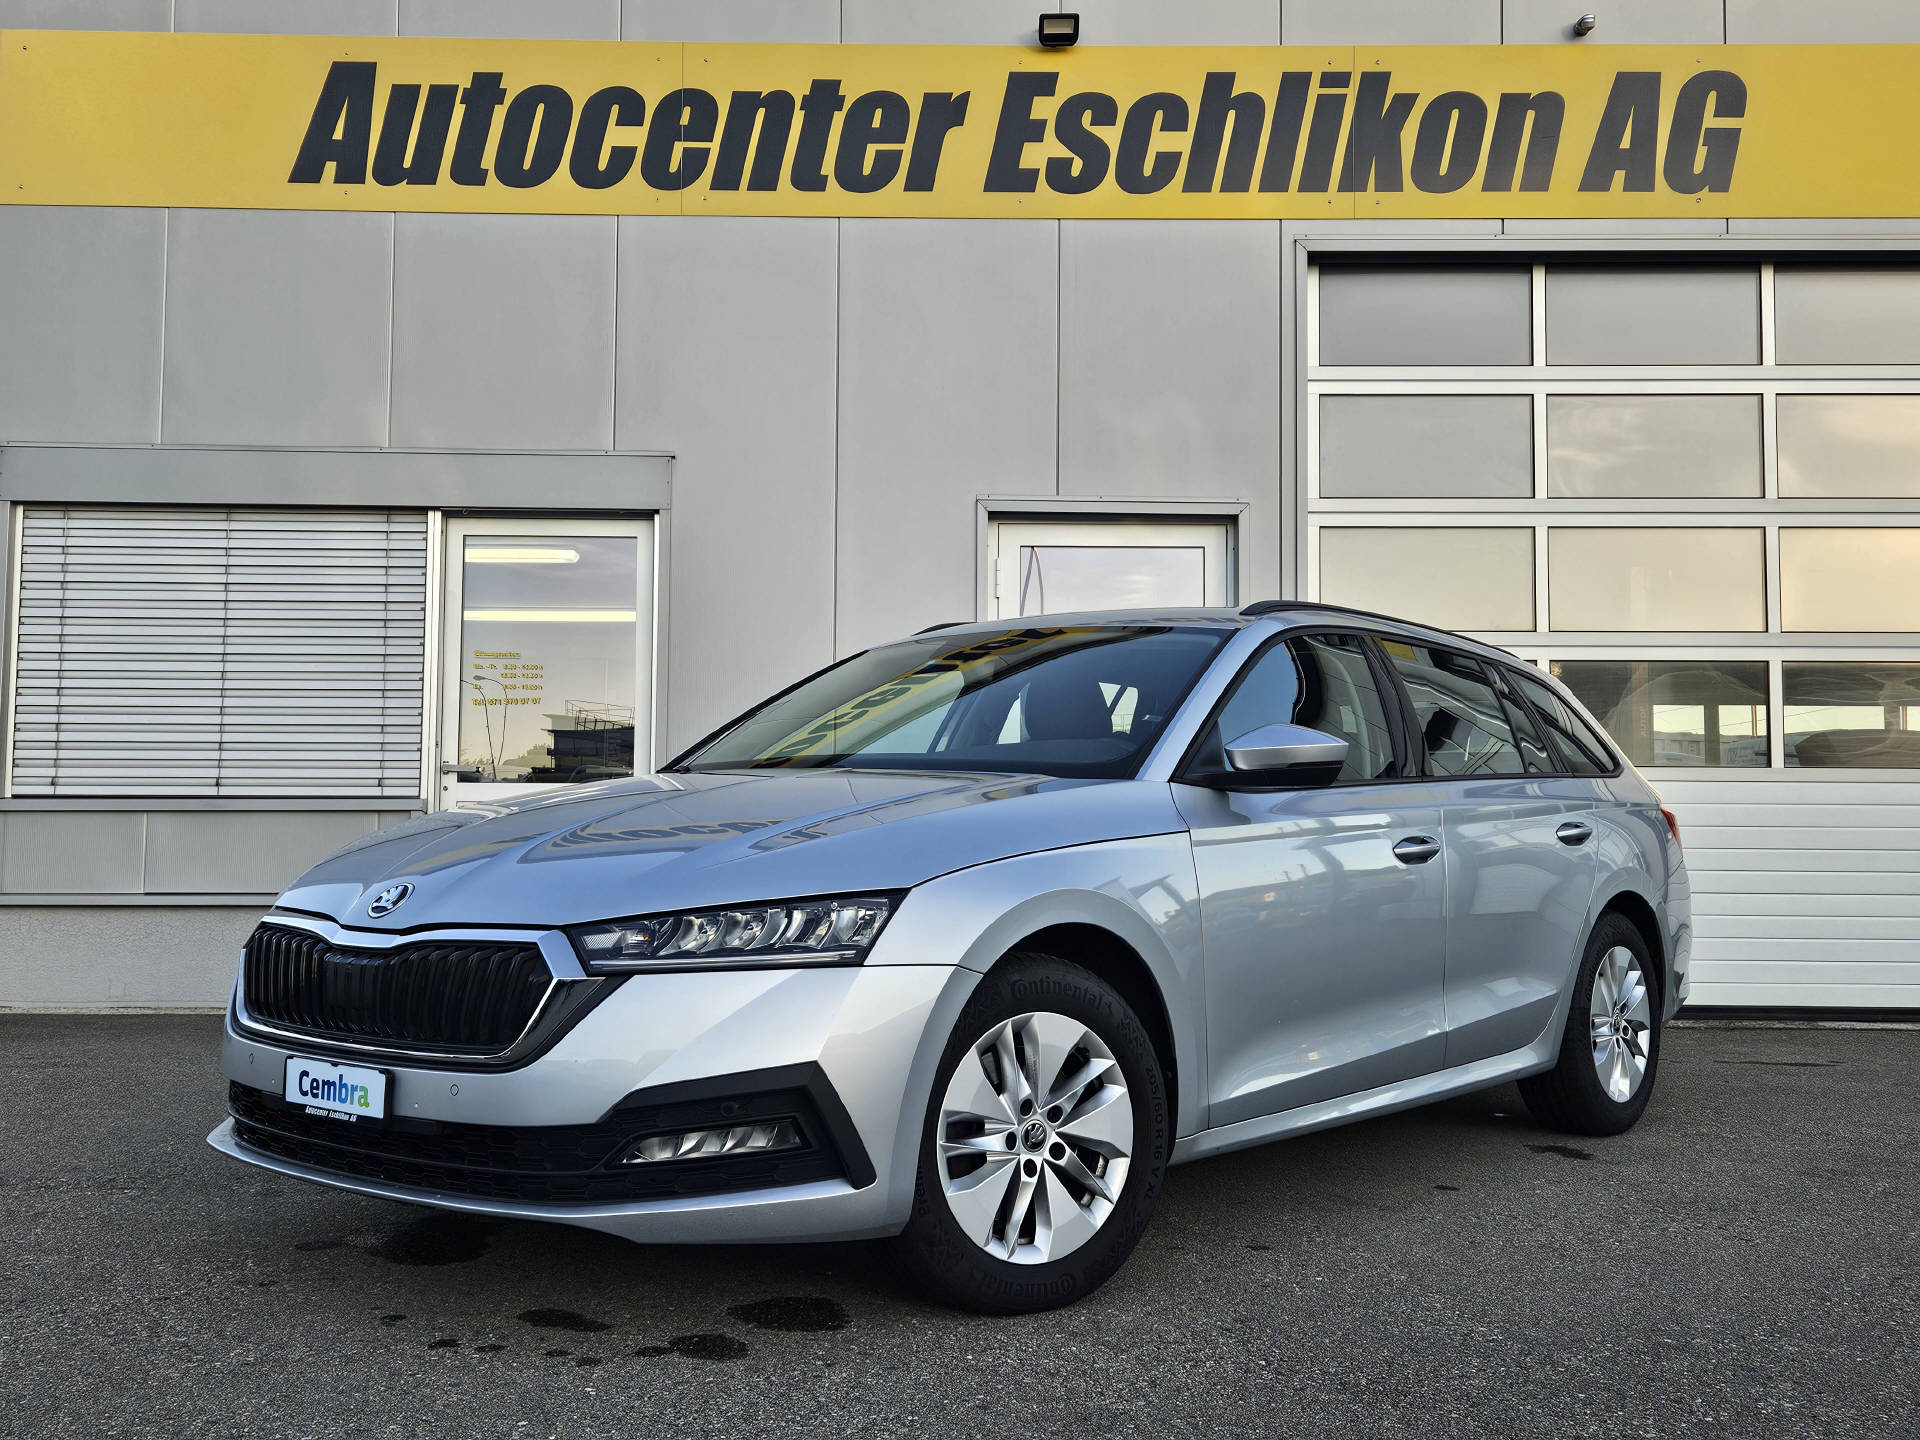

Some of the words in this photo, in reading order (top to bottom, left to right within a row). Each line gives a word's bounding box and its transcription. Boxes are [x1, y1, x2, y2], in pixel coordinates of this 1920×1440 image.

[288, 61, 971, 193] Autocenter
[983, 71, 1566, 194] Eschlikon
[1577, 70, 1748, 195] AG
[298, 1070, 370, 1108] Cembra
